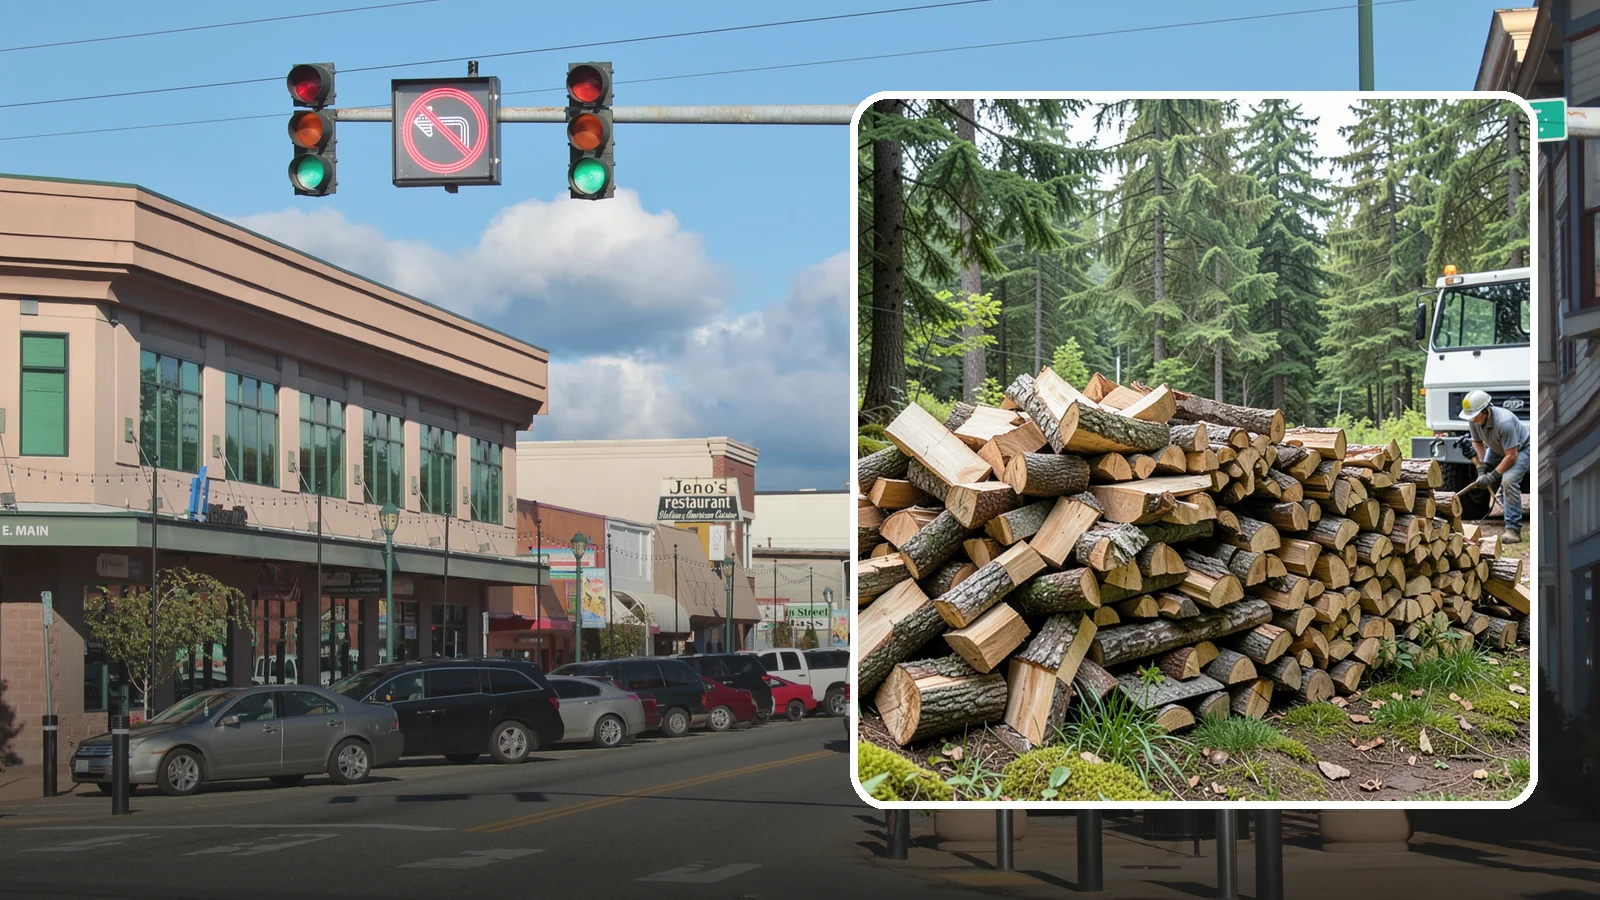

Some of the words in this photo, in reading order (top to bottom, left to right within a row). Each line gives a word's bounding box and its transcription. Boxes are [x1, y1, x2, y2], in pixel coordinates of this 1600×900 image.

[669, 480, 727, 495] Jeno's
[665, 496, 731, 509] restaurant
[658, 509, 681, 519] Italian
[686, 510, 715, 519] American
[715, 509, 738, 519] Cuisine
[2, 525, 13, 536] E.
[15, 525, 49, 536] MAIN
[797, 607, 828, 616] Street
[791, 619, 823, 627] lass
